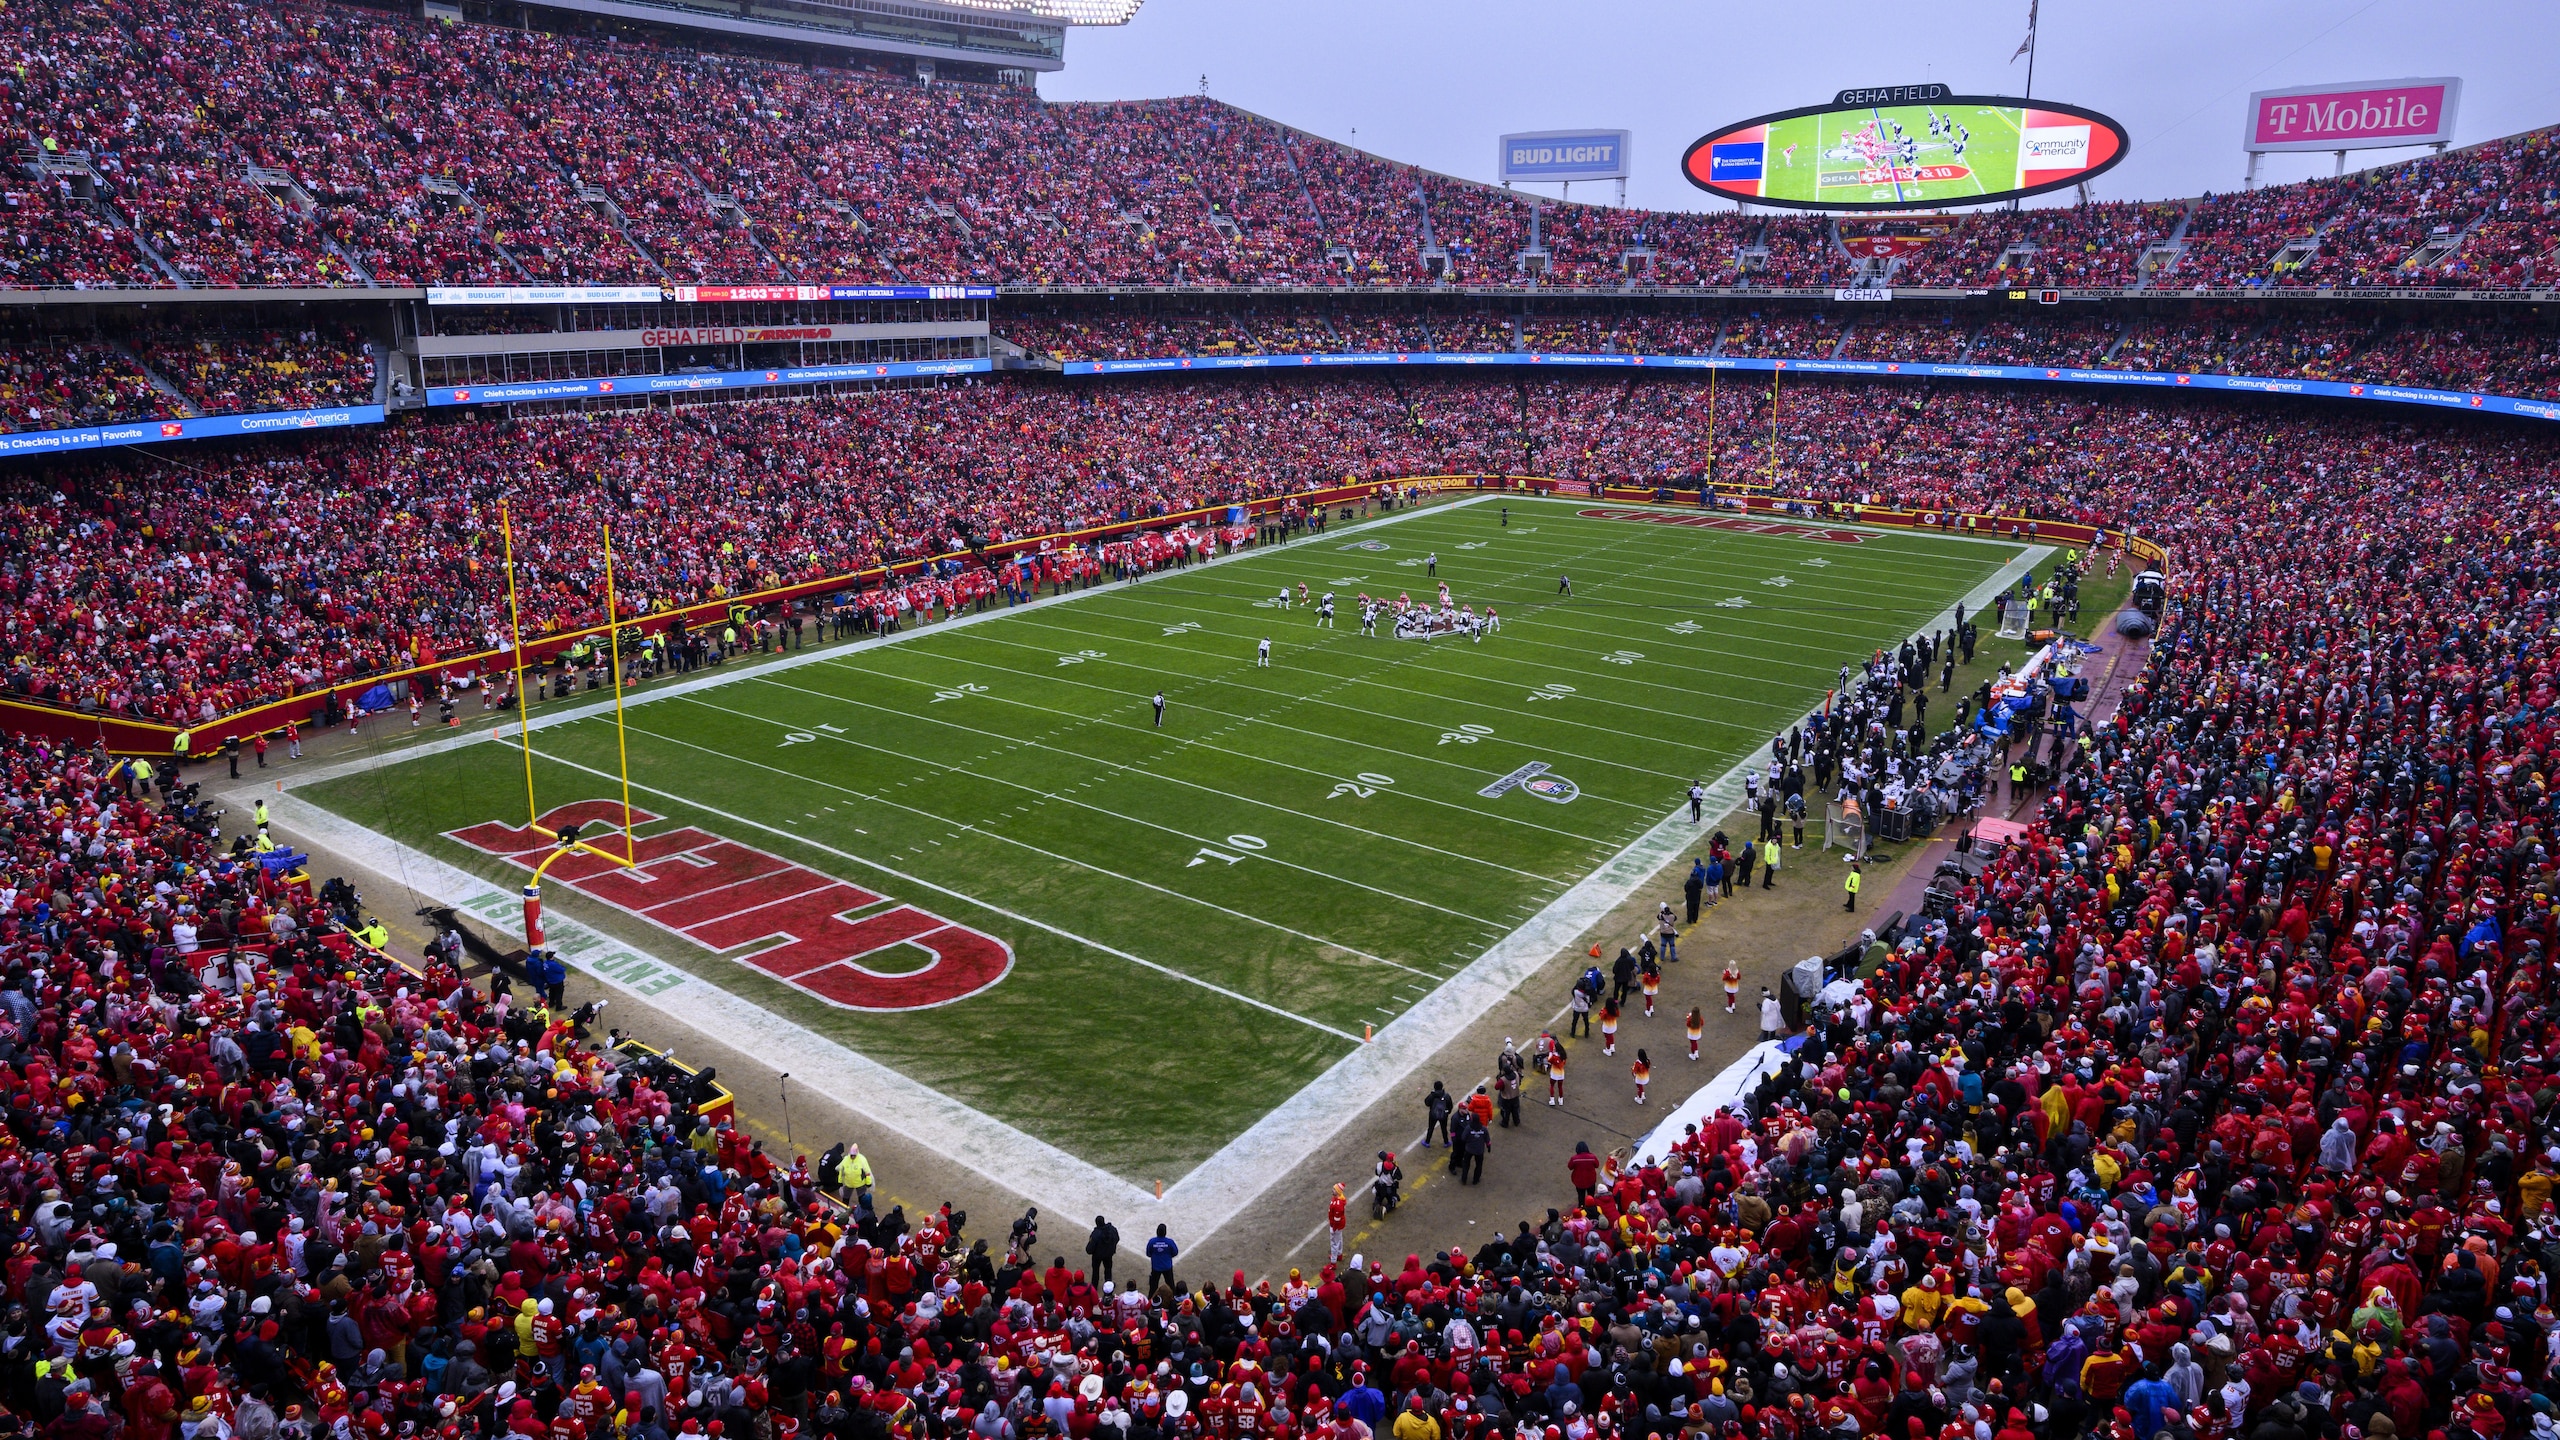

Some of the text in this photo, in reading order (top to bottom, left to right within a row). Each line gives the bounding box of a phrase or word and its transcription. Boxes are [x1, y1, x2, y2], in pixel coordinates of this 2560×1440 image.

[1842, 85, 1941, 104] GEHA FIELD
[2270, 96, 2428, 134] T Mobile
[2026, 138, 2086, 149] Community
[1513, 146, 1613, 164] BUD LIGHT
[1822, 168, 1952, 183] GEHA & 10
[730, 289, 767, 299] 12:03
[1843, 290, 1883, 300] GEHA
[2009, 291, 2026, 300] 12:03
[2045, 293, 2056, 301] 11
[642, 328, 831, 346] GEHA FIELD ARROWHEAD
[916, 363, 973, 373] CommunityAmerica
[1933, 366, 2002, 376] CommunityAmerica
[651, 376, 722, 388] CommunityAmerica
[2228, 379, 2302, 391] CommunityAmerica
[2392, 391, 2418, 399] Checking
[242, 413, 349, 428] CommunityAmerica
[12, 437, 60, 448] Checking
[62, 436, 70, 444] is
[81, 434, 99, 442] Fan
[102, 430, 142, 440] Favorite
[1576, 509, 1886, 543] CHIEFS
[1164, 621, 1202, 634] 40
[1666, 621, 1703, 634] 40
[1058, 650, 1108, 665] 30
[1602, 650, 1645, 665] 50
[934, 682, 989, 700] 20
[1532, 684, 1576, 701] 40
[784, 723, 848, 744] 10
[1441, 724, 1494, 744] 30
[1334, 772, 1394, 798] 20
[1484, 764, 1544, 794] DIVISIONAL
[1196, 834, 1268, 866] 10
[440, 800, 1016, 1012] CHIEFS
[592, 952, 686, 996] END
[1769, 1126, 1780, 1136] 15
[2040, 1186, 2052, 1200] 58
[921, 1244, 935, 1256] 87
[1978, 1258, 1990, 1269] 87
[385, 1265, 398, 1278] 15
[2269, 1272, 2291, 1286] 92
[533, 1329, 548, 1343] 25
[1862, 1328, 1881, 1342] 16
[2276, 1352, 2295, 1366] 56
[668, 1363, 685, 1376] 87
[1826, 1360, 1842, 1377] 15
[707, 1393, 722, 1406] 41
[575, 1402, 594, 1416] 52
[1209, 1415, 1224, 1427] 15
[1238, 1415, 1255, 1428] 58
